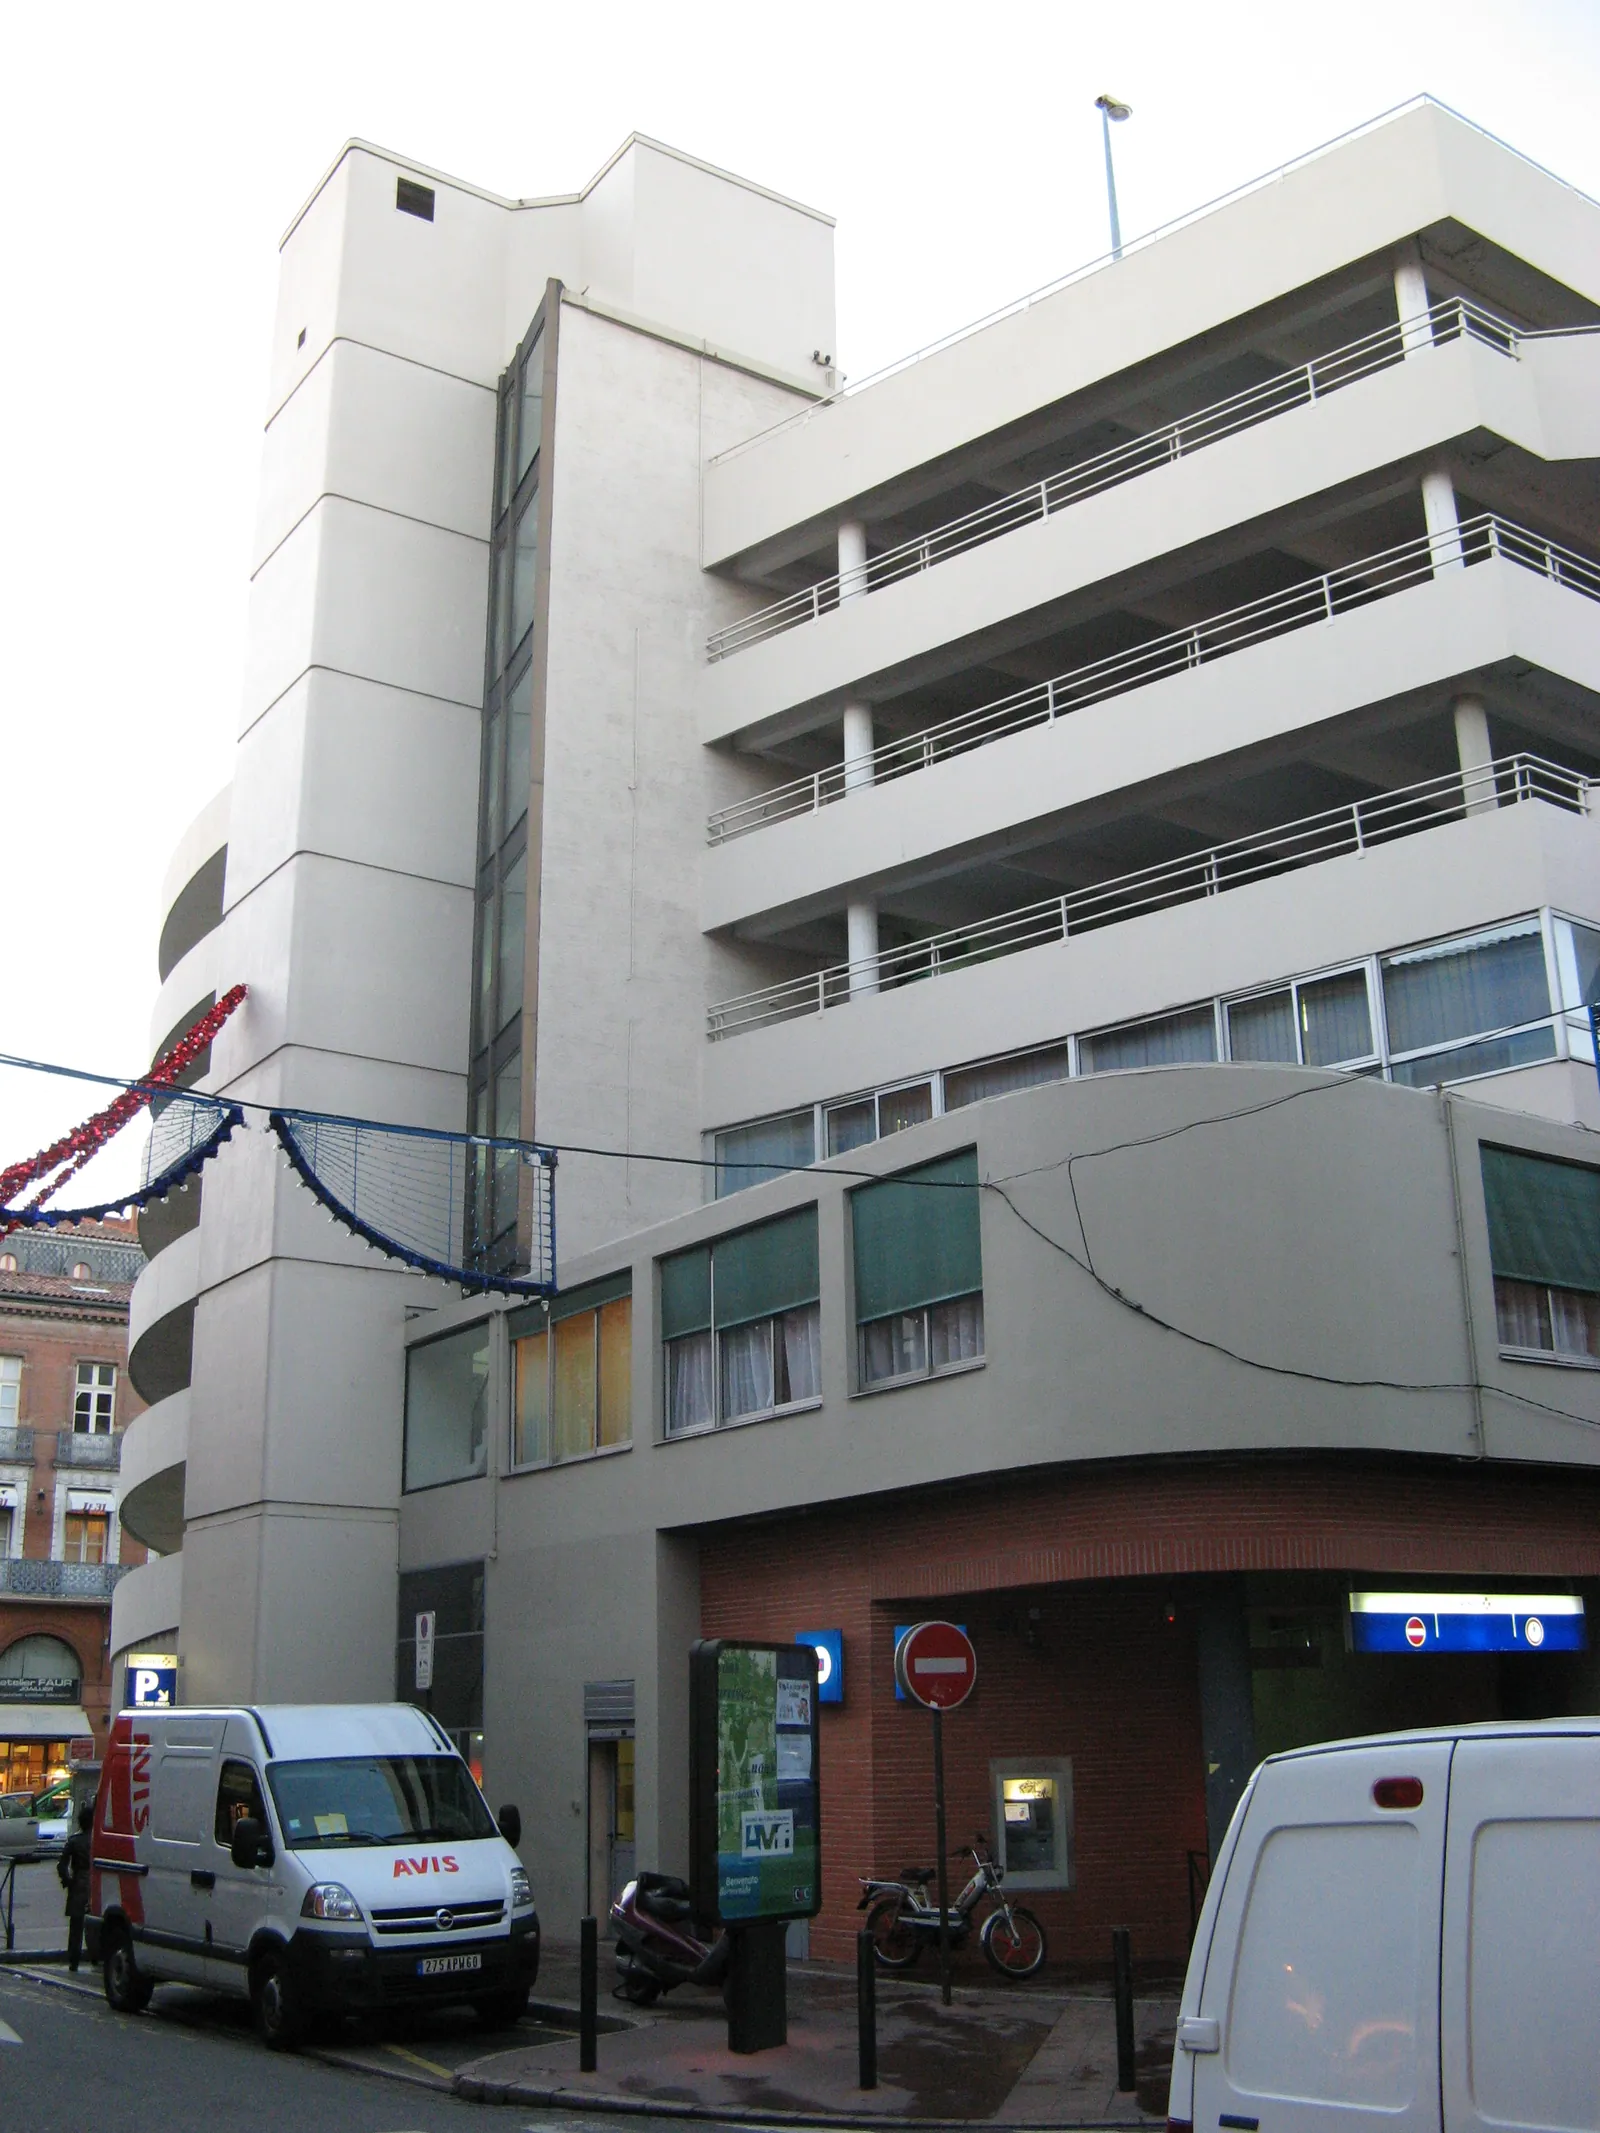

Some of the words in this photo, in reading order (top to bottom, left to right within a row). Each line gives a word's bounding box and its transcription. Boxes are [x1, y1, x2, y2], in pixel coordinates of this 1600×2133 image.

[135, 1670, 159, 1701] P
[132, 1733, 151, 1834] AVIS
[393, 1855, 460, 1878] AVIS
